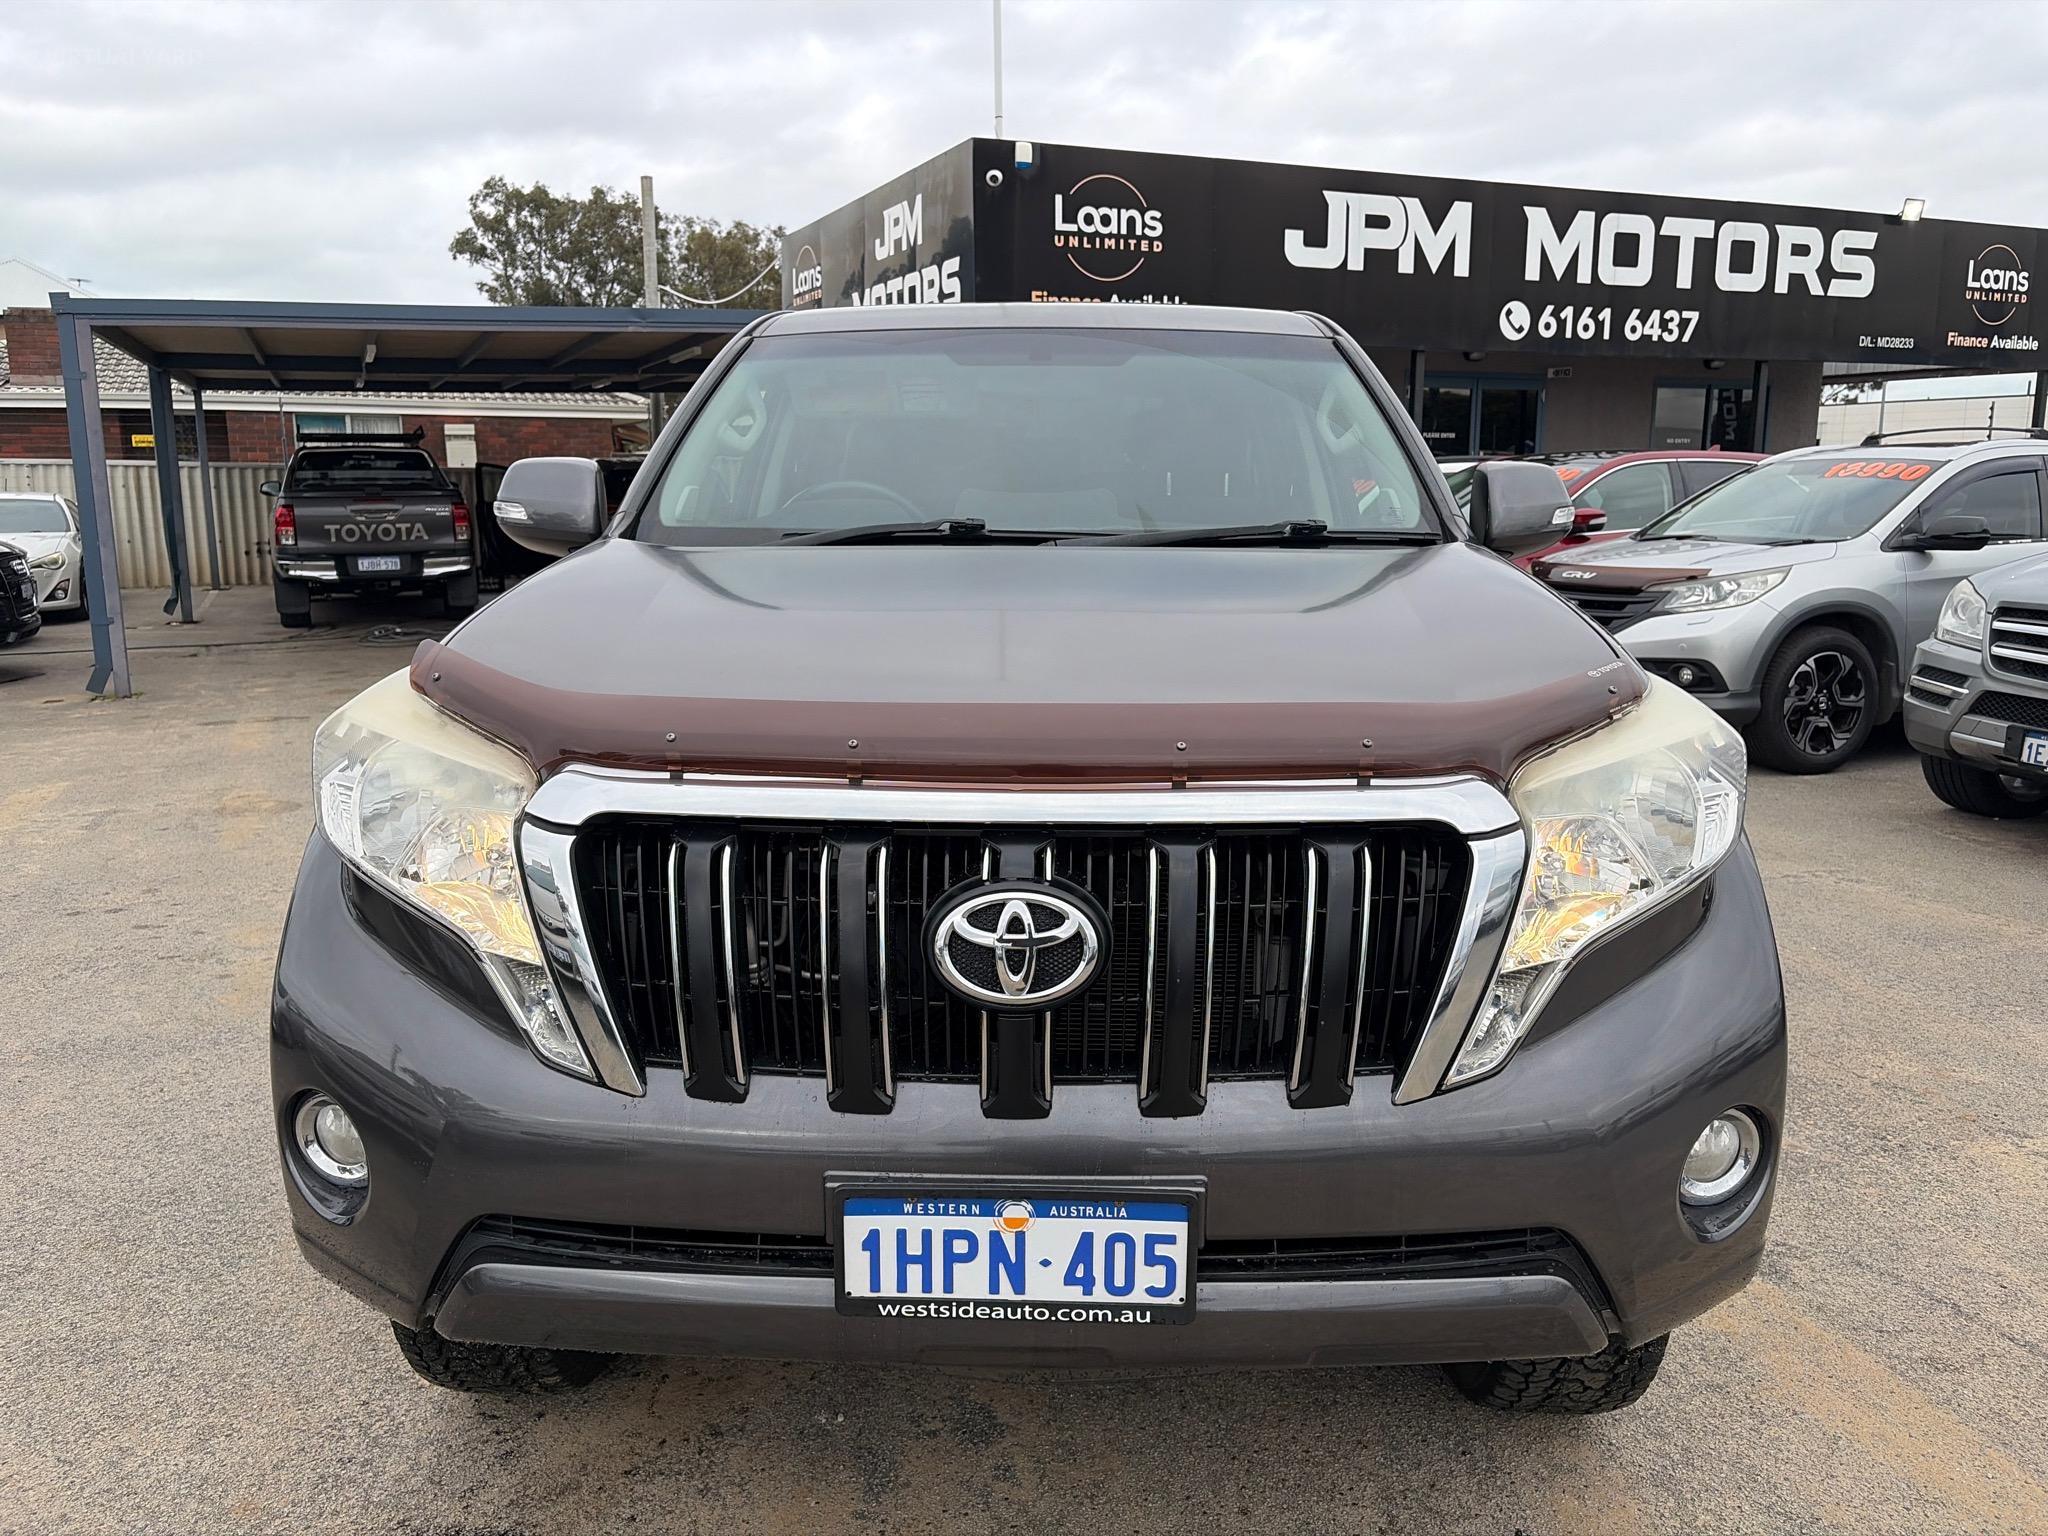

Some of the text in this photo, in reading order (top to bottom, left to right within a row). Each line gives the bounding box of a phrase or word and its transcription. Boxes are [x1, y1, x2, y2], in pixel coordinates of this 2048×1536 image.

[1054, 194, 1164, 238] Loans
[875, 193, 923, 261] JPM
[1054, 235, 1163, 252] UNLIMITED
[1284, 190, 1879, 299] JPM MOTORS
[792, 265, 822, 296] Loans
[1966, 259, 2030, 292] Loans
[1965, 290, 2028, 303] UNLIMITED
[1537, 304, 1700, 343] 6161 6437
[1859, 335, 1915, 349] D/L: MD28233
[1946, 331, 2039, 351] Finance Available
[1824, 462, 1932, 481] 13990
[324, 522, 429, 543] TOYOTA
[903, 1203, 1128, 1218] WESTERN AUSTRALIA
[878, 1301, 1151, 1323] westsideauto.com.au
